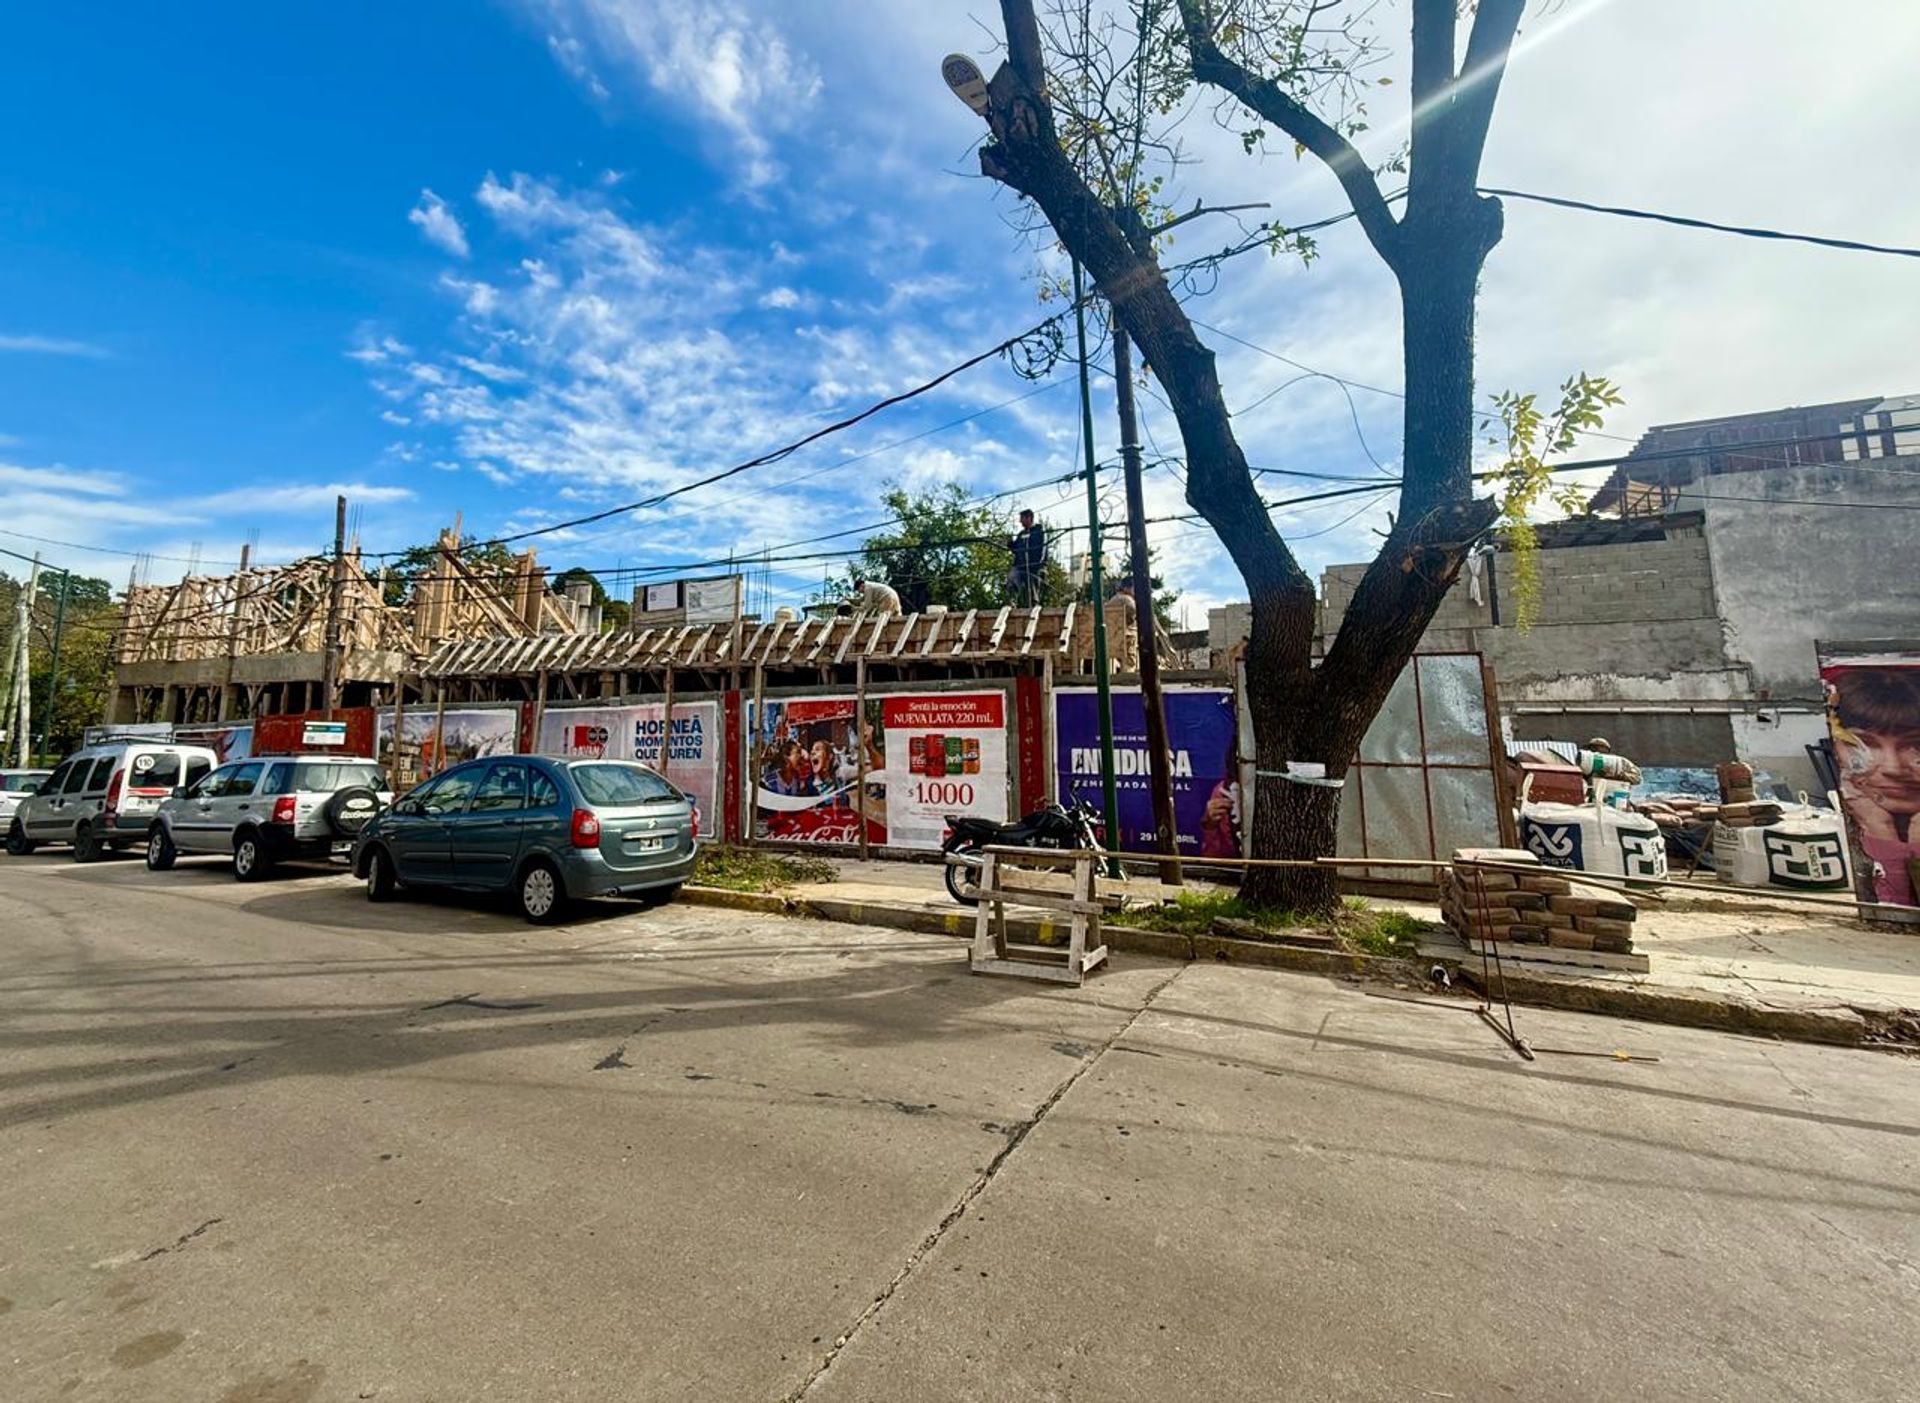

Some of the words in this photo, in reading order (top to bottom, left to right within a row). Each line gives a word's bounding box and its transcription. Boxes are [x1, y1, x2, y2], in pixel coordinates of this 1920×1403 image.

[931, 700, 939, 710] la
[940, 700, 977, 710] emoción
[894, 713, 927, 724] NUEVA
[928, 713, 954, 724] LATA
[956, 713, 975, 723] 220
[634, 735, 703, 747] MOMNTOS
[634, 748, 658, 760] QUE
[665, 747, 702, 759] UREN
[1074, 779, 1148, 789] TEMPRADA
[1140, 832, 1152, 841] 29
[1174, 834, 1199, 844] BRIL
